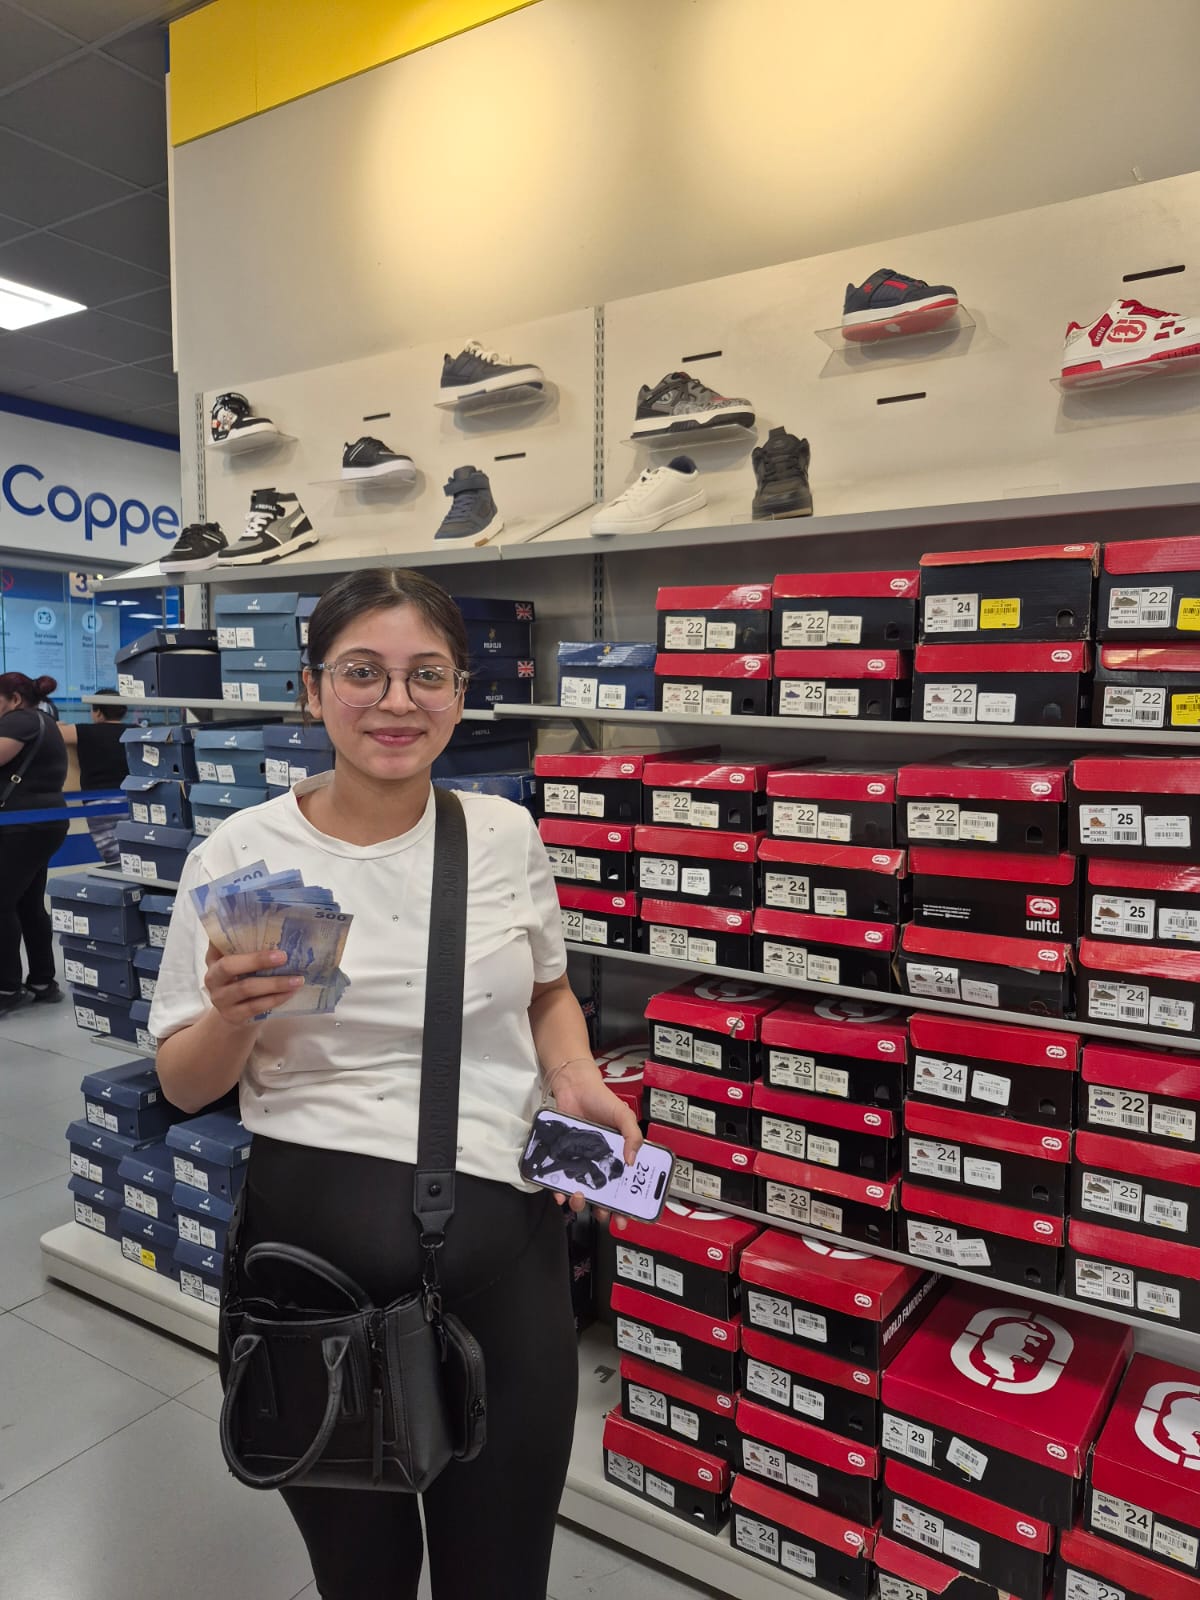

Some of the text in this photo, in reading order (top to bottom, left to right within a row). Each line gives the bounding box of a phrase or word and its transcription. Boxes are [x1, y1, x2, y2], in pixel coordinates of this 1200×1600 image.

[2, 464, 180, 547] Coppe
[76, 573, 88, 592] 3
[1148, 592, 1168, 604] 22
[957, 602, 970, 613] 24
[687, 622, 702, 634] 22
[807, 618, 824, 629] 22
[582, 684, 591, 694] 24
[805, 686, 822, 700] 25
[953, 689, 973, 702] 22
[684, 690, 700, 702] 22
[1142, 692, 1161, 704] 22
[562, 790, 576, 800] 22
[674, 797, 688, 808] 22
[798, 810, 814, 822] 22
[936, 810, 955, 822] 22
[1118, 814, 1134, 825] 25
[560, 853, 574, 864] 24
[660, 864, 676, 876] 23
[789, 880, 806, 892] 24
[314, 911, 347, 922] 500
[1130, 906, 1146, 918] 25
[567, 915, 580, 927] 22
[670, 933, 685, 944] 23
[786, 952, 804, 964] 23
[934, 971, 954, 984] 24
[1126, 989, 1144, 1002] 24
[675, 1034, 690, 1048] 24
[794, 1060, 811, 1074] 25
[943, 1066, 964, 1082] 24
[670, 1098, 685, 1111] 23
[1120, 1096, 1144, 1114] 22
[786, 1128, 802, 1142] 25
[937, 1148, 956, 1162] 24
[676, 1164, 690, 1178] 24
[630, 1162, 649, 1196] 2:26
[1120, 1185, 1138, 1199] 25
[790, 1192, 806, 1206] 23
[934, 1230, 953, 1243] 24
[639, 1256, 650, 1268] 23
[192, 1278, 202, 1288] 23
[1112, 1271, 1130, 1285] 23
[772, 1302, 789, 1318] 24
[636, 1328, 652, 1344] 26
[770, 1372, 788, 1388] 24
[649, 1394, 664, 1410] 24
[911, 1430, 925, 1444] 29
[768, 1455, 780, 1468] 25
[627, 1460, 642, 1478] 23
[1125, 1508, 1148, 1530] 24
[924, 1520, 937, 1533] 25
[758, 1527, 775, 1544] 24
